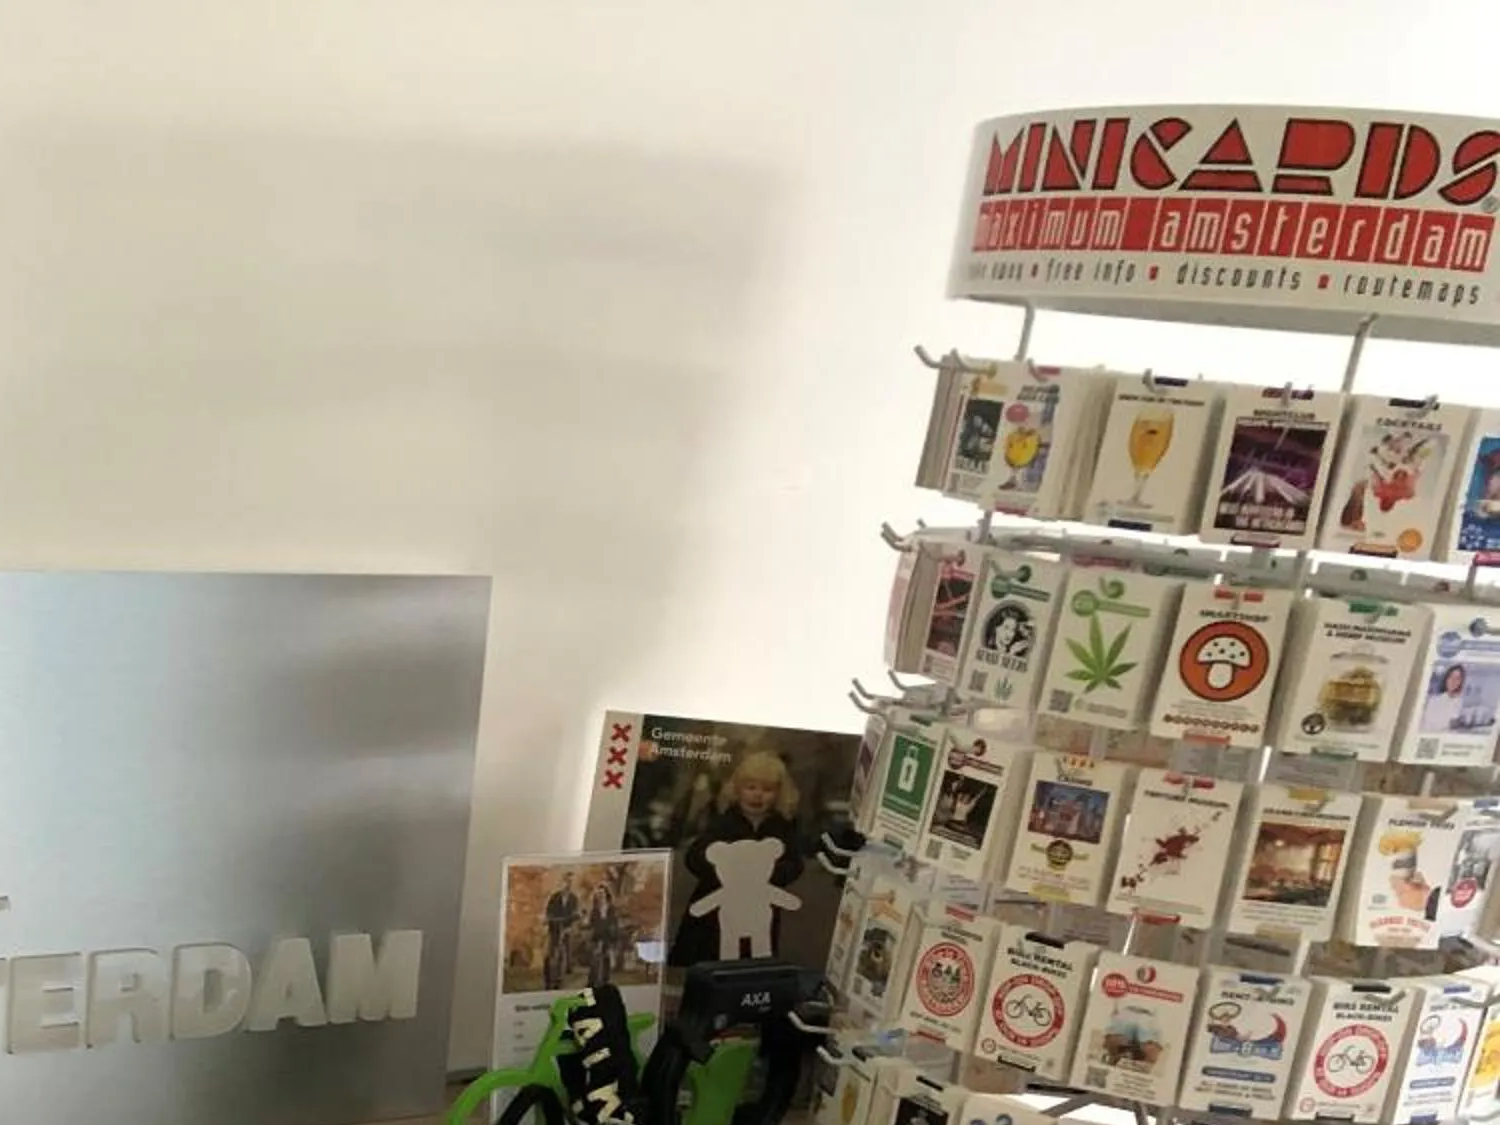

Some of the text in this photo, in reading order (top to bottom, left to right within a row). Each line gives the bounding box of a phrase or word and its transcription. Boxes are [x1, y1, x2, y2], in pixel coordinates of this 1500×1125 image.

[1159, 204, 1490, 270] amsterdam
[1046, 258, 1084, 283] free
[1092, 259, 1137, 285] info
[1176, 261, 1301, 291] discounts
[1343, 274, 1481, 307] routemaps
[649, 742, 733, 764] Amsterdam
[740, 991, 771, 1008] AXA
